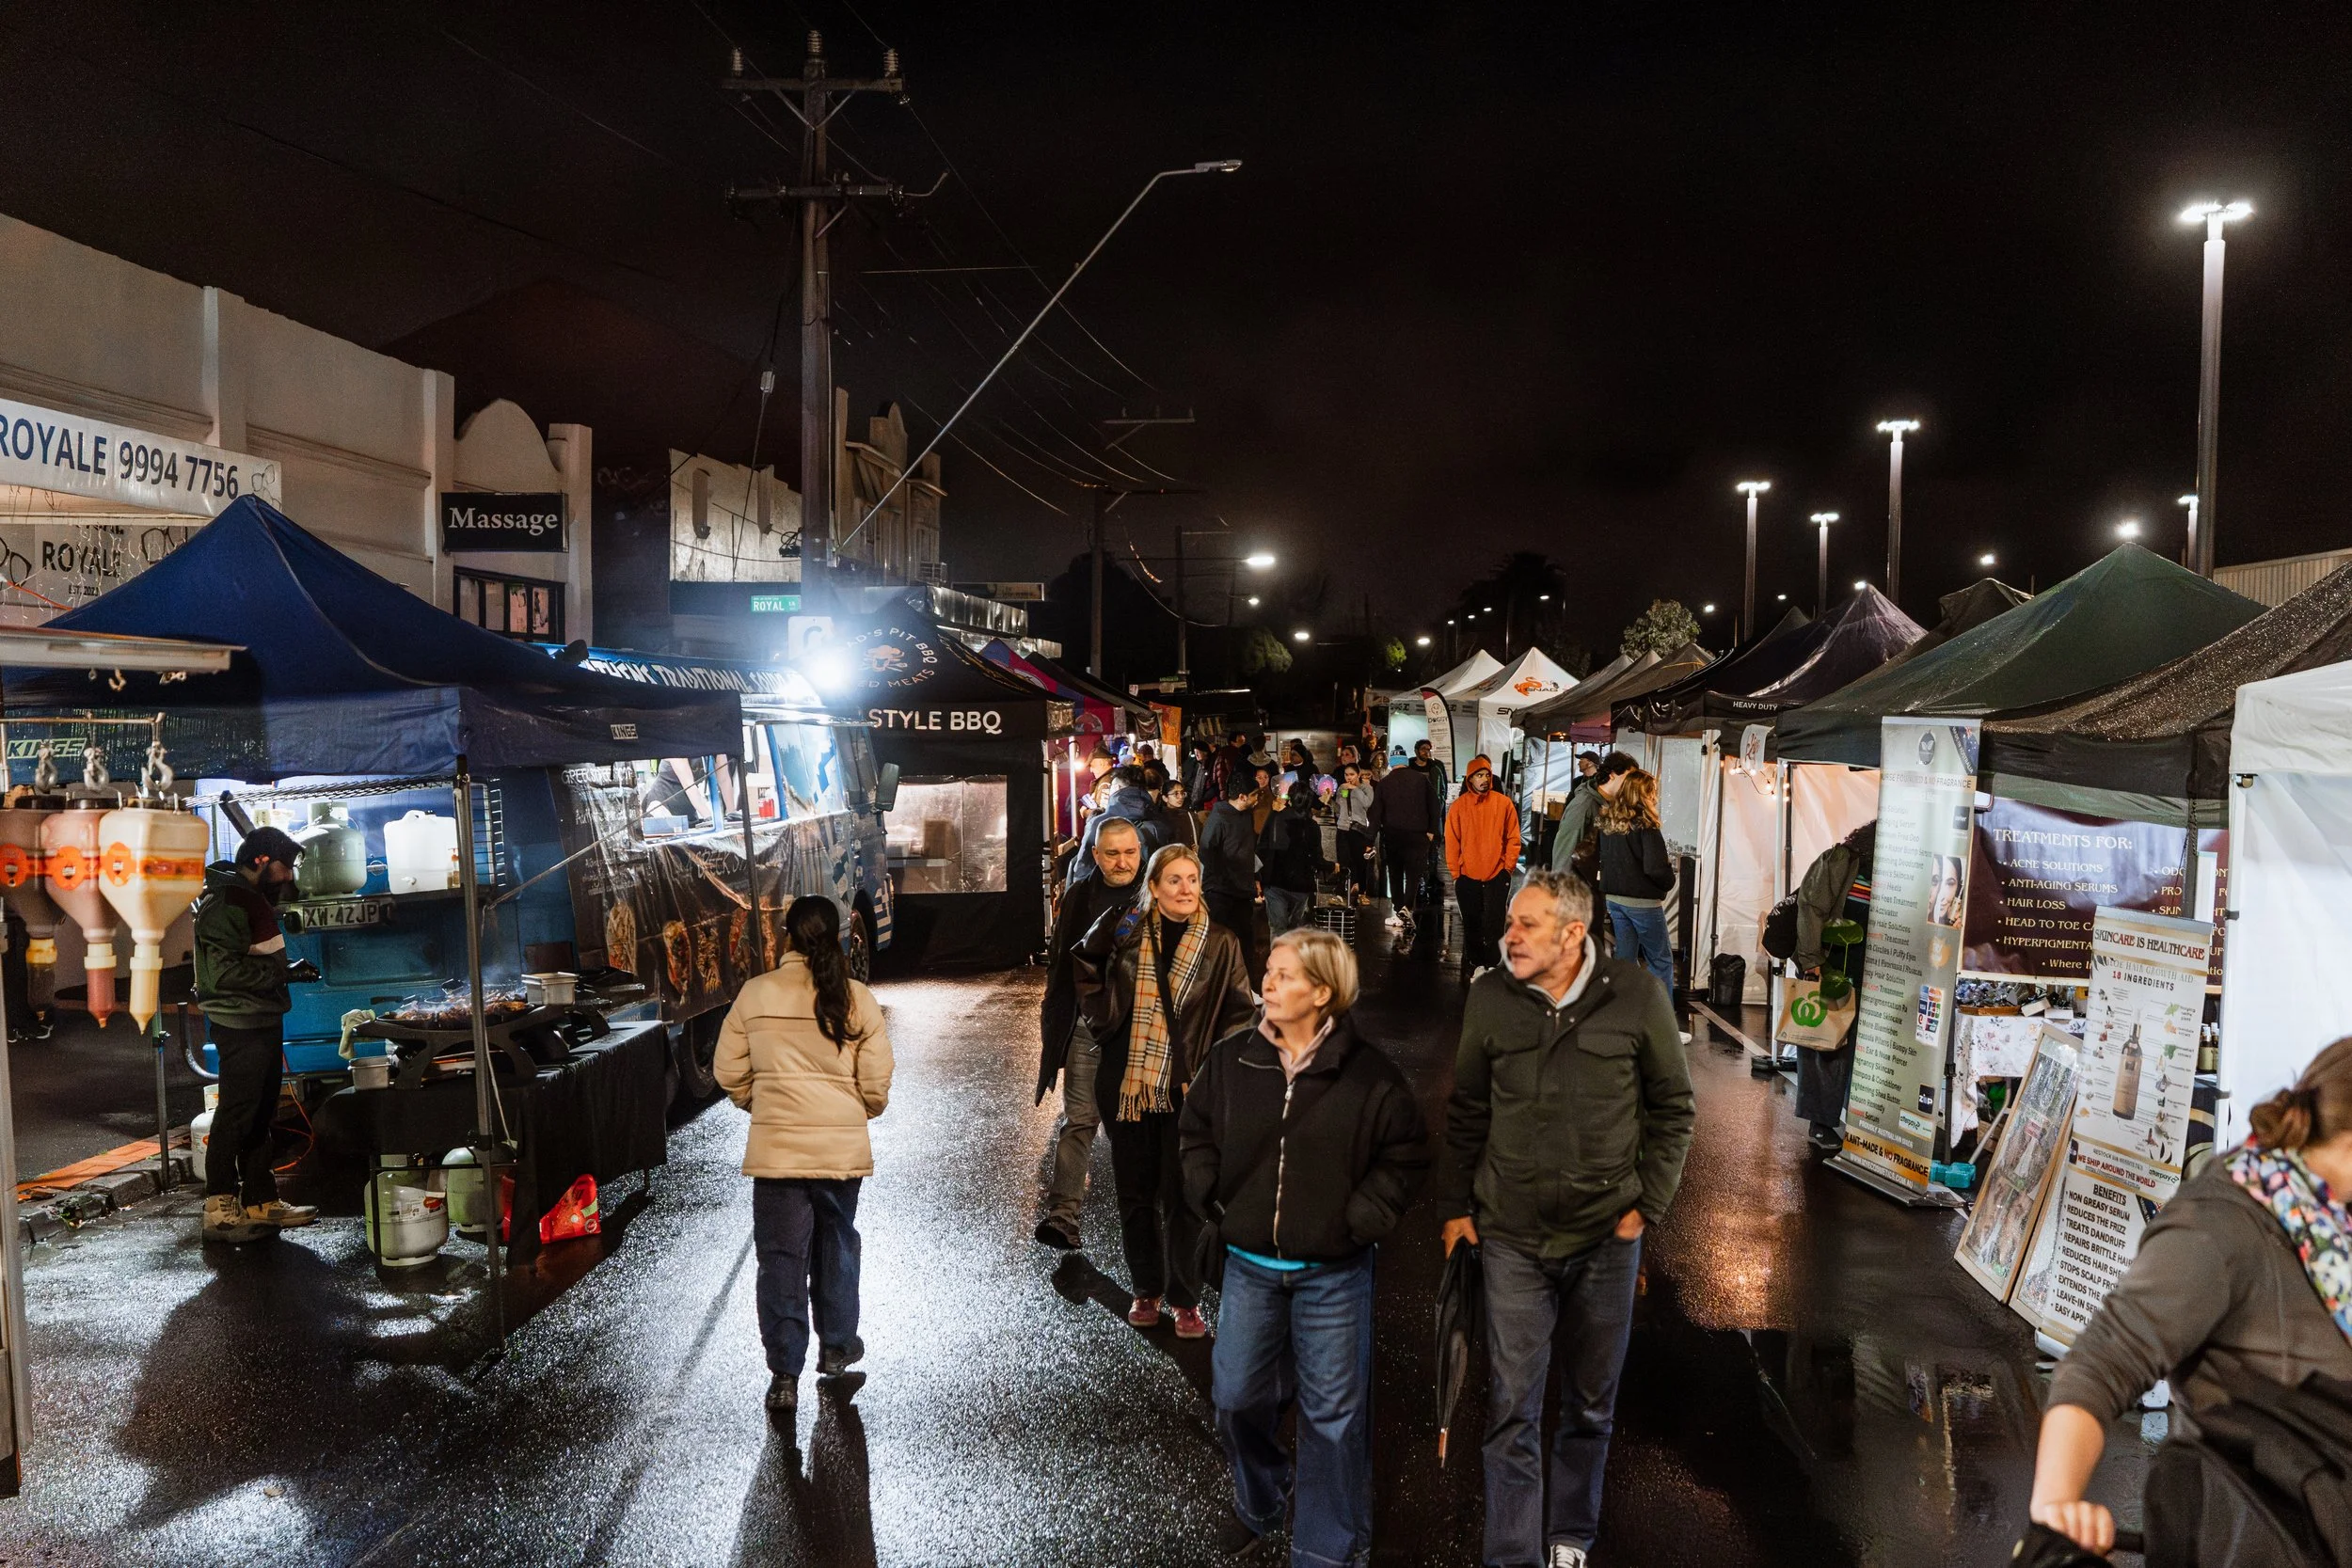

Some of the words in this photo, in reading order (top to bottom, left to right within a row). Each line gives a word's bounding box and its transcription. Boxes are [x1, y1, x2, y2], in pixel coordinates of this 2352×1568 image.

[119, 441, 178, 488] 9994
[185, 455, 239, 499] 7756
[449, 507, 558, 535] Massage
[42, 540, 120, 578] ROYALE
[754, 601, 785, 611] ROYAL
[889, 626, 916, 641] PIT
[915, 641, 938, 664] BBQ
[887, 669, 935, 689] MEATS
[1733, 701, 1756, 709] HEAVY
[612, 724, 638, 739] KINGS
[868, 708, 942, 730] STYLE
[950, 711, 1002, 735] BBQ
[1937, 778, 1972, 789] FRAGRANCE
[1994, 829, 2090, 847] TREATMENTS
[2096, 835, 2133, 849] FOR:
[2010, 859, 2040, 869] ACNE
[2042, 860, 2104, 873] SOLUTIONS
[2009, 879, 2072, 891] ANTI-AGING
[2074, 882, 2118, 894] SERUMS
[2007, 897, 2034, 908] HAIR
[2037, 899, 2066, 911] LOSS
[2005, 917, 2035, 927] HEAD
[2039, 919, 2055, 928] TO
[2058, 920, 2080, 930] TOE
[2094, 928, 2135, 946] SKINCARE
[2137, 936, 2145, 948] IS
[2146, 939, 2205, 960] HEALTHCARE
[2049, 958, 2082, 969] Where
[2126, 961, 2144, 973] HAIR
[2146, 966, 2177, 981] GROWTH
[2179, 973, 2194, 984] AID
[2112, 971, 2122, 979] 18
[2123, 973, 2175, 991] INGREDIENTS
[1844, 1131, 1879, 1155] PLANT-MADE
[1878, 1148, 1883, 1158] &
[1883, 1148, 1893, 1161] NO
[1893, 1153, 1929, 1177] FRAGRANCE
[2077, 1154, 2086, 1164] WE
[2087, 1156, 2100, 1167] SHIP
[2100, 1161, 2125, 1177] AROUND
[2125, 1169, 2135, 1181] THE
[2136, 1174, 2156, 1188] WORLD
[2093, 1183, 2126, 1205] BENEFITS
[2069, 1190, 2083, 1202] NON
[2083, 1196, 2108, 1212] GREASY
[2108, 1206, 2131, 1222] SERUM
[2067, 1204, 2095, 1222] REDUCES
[2096, 1215, 2109, 1227] THE
[2109, 1220, 2126, 1235] FRIZZ
[2066, 1217, 2090, 1234] TREATS
[2090, 1227, 2126, 1249] DANDRUFF
[2062, 1245, 2091, 1266] REDUCES
[2092, 1259, 2108, 1272] HAIR
[2063, 1232, 2090, 1250] REPAIRS
[2090, 1243, 2117, 1260] BRITTLE
[2118, 1255, 2133, 1267] HAIR
[2059, 1259, 2080, 1275] STOPS
[2081, 1270, 2102, 1286] SCALP
[2057, 1289, 2085, 1308] LEAVE-IN
[2058, 1275, 2087, 1294] EXTENDS
[2088, 1289, 2101, 1301] THE
[2055, 1303, 2071, 1317] EASY
